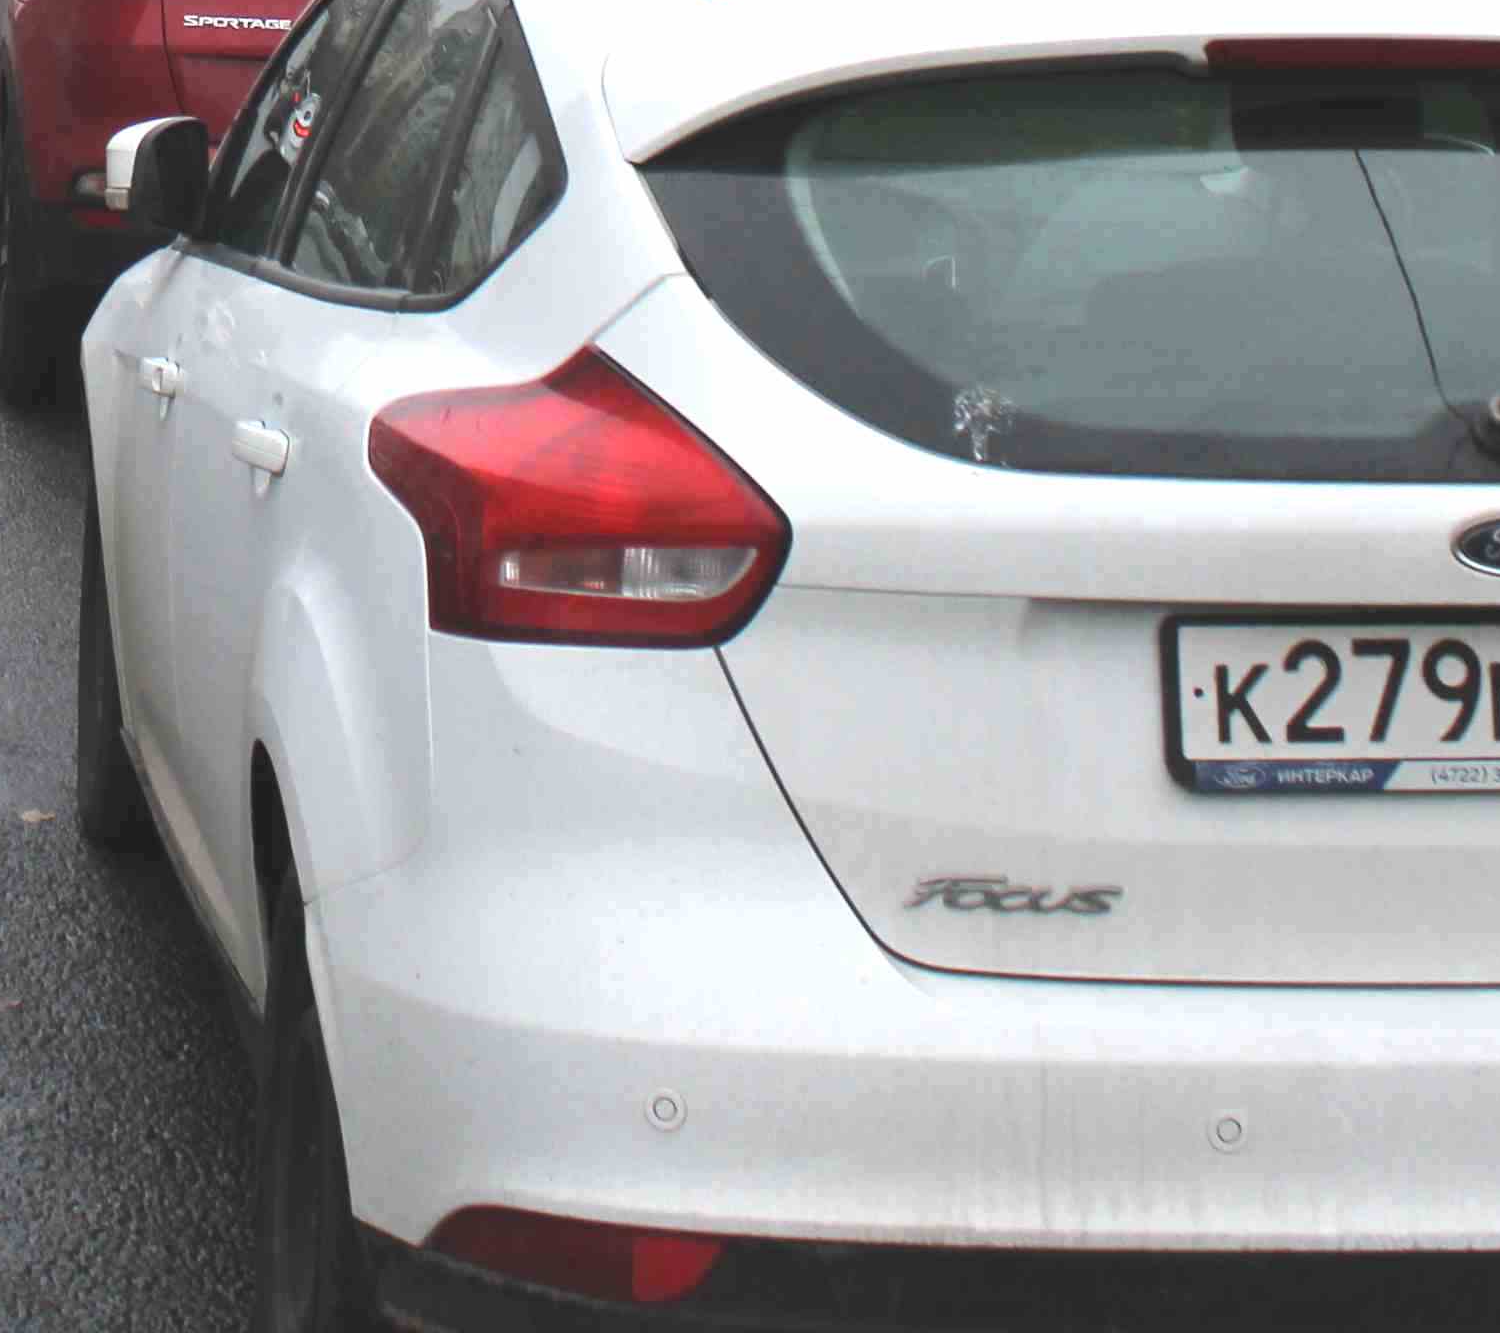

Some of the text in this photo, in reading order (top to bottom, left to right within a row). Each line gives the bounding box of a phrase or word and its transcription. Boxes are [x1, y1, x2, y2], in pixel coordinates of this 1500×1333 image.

[183, 14, 293, 31] SPORTAGE
[1277, 766, 1376, 784] ИНТЕРКАР
[1430, 767, 1488, 785] (4722)
